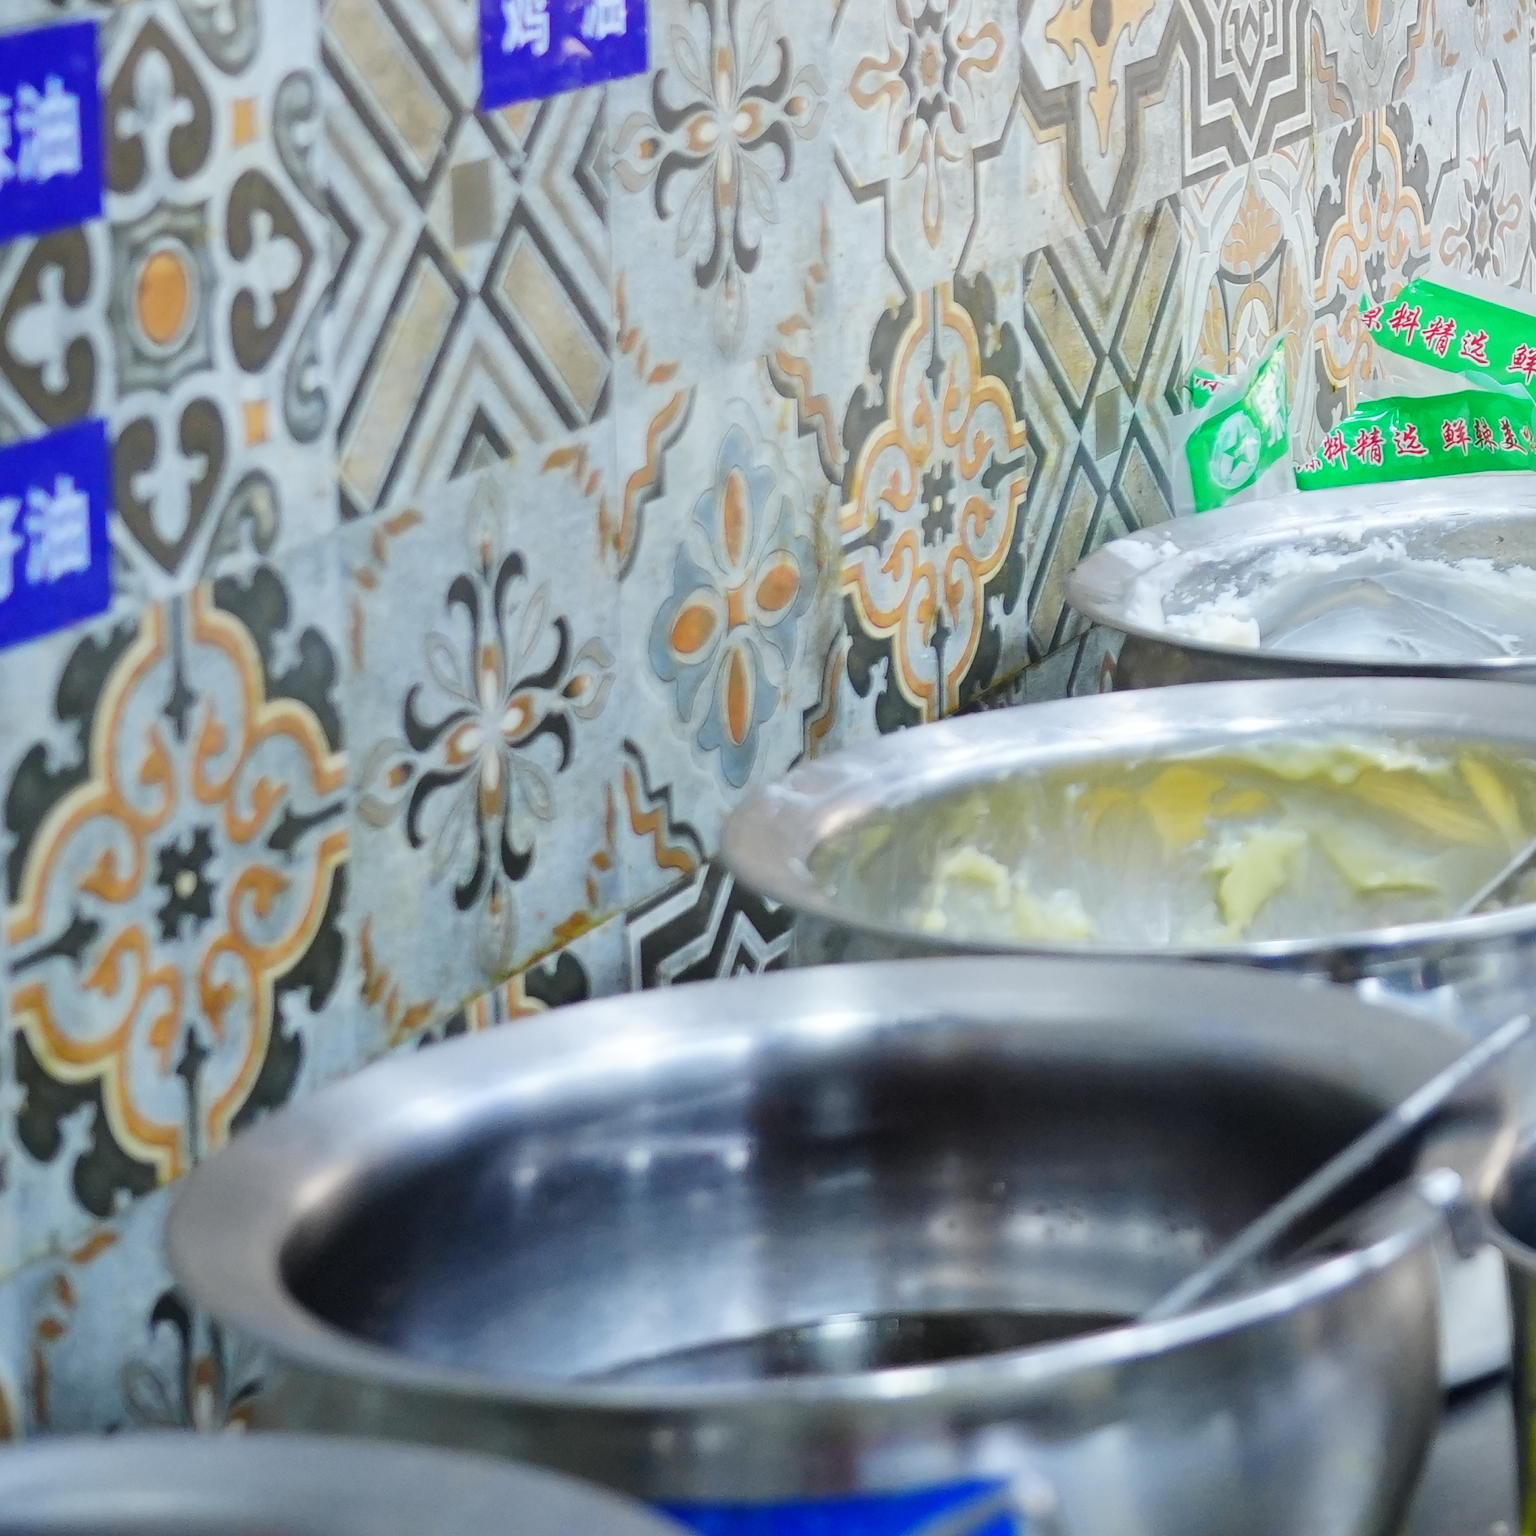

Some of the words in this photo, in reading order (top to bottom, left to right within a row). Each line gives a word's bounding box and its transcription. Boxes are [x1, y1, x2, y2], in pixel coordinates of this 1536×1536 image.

[0, 71, 83, 191] 油
[1298, 424, 1428, 471] 料精选
